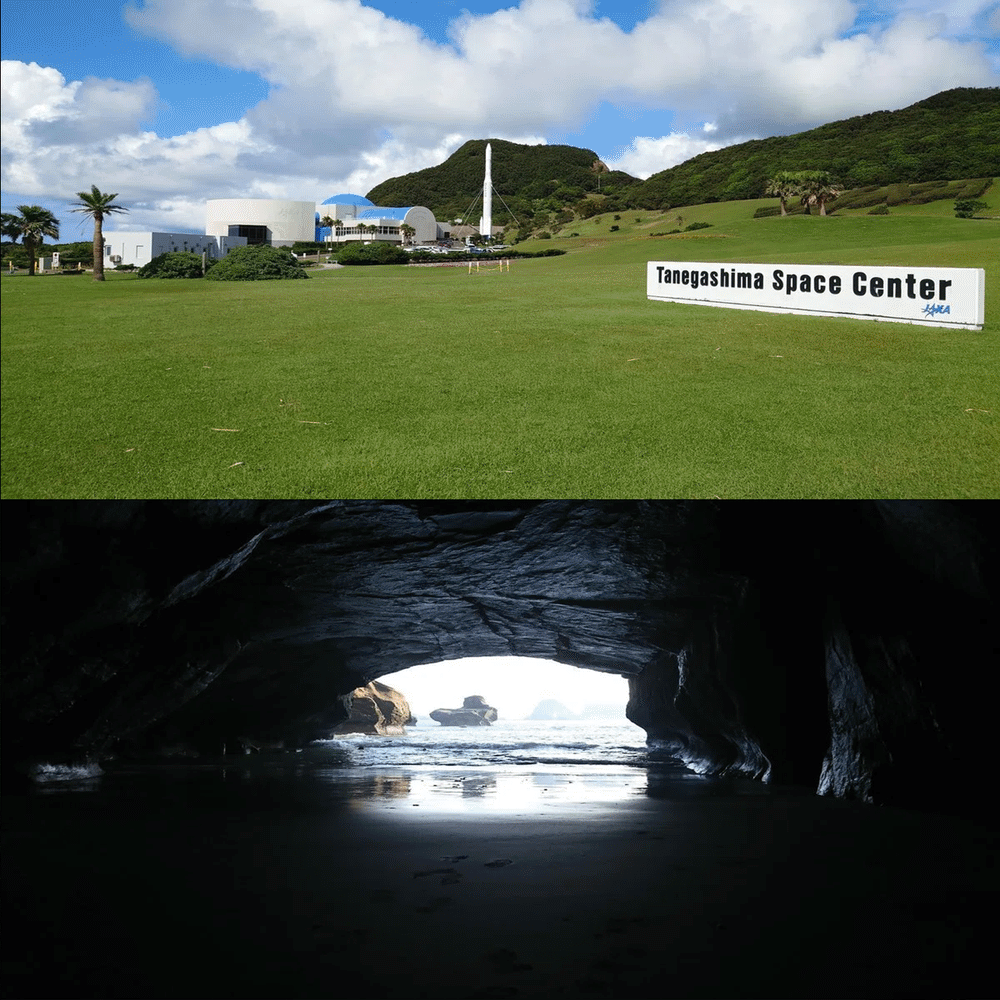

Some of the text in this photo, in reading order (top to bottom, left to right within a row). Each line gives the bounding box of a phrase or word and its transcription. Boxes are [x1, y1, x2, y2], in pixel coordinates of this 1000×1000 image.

[656, 266, 952, 301] Tanegashima Space Center
